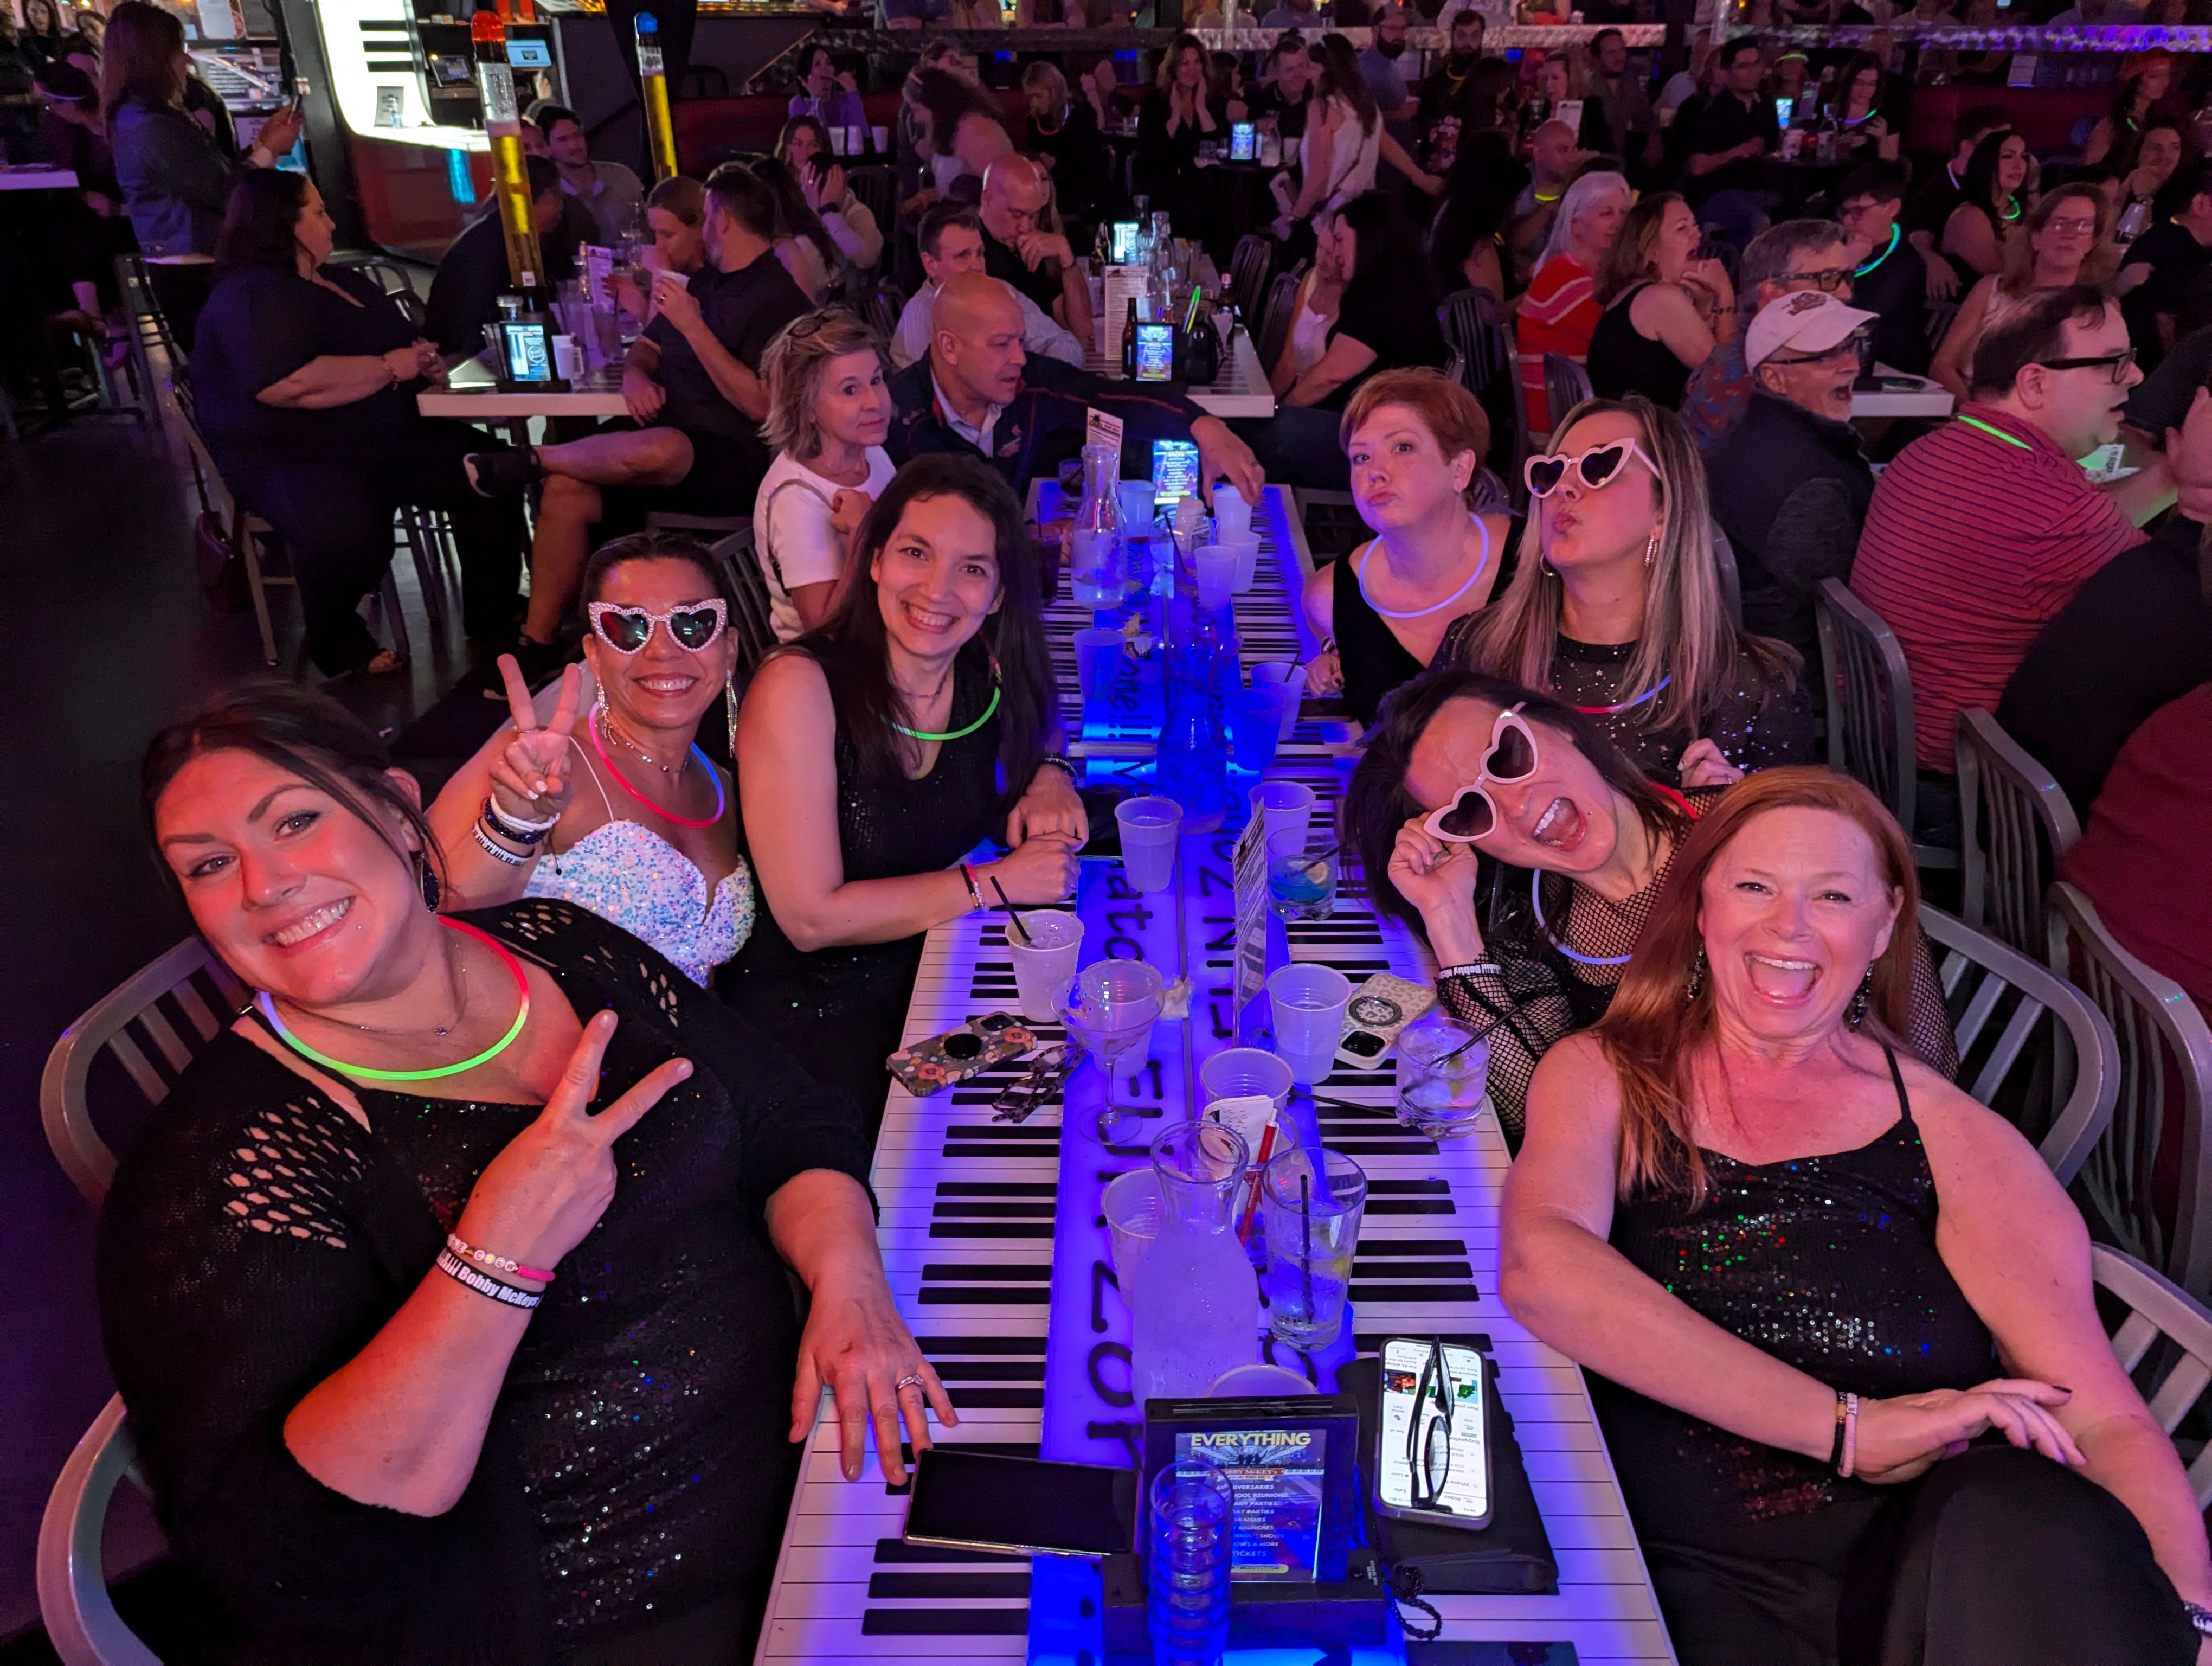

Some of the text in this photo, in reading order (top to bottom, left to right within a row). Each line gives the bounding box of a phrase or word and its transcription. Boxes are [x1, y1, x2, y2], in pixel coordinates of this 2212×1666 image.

[1454, 965, 1481, 976] Bobby
[476, 1251, 516, 1270] CREW
[457, 1265, 500, 1296] Bobby
[1191, 1432, 1311, 1446] EVERYTHING
